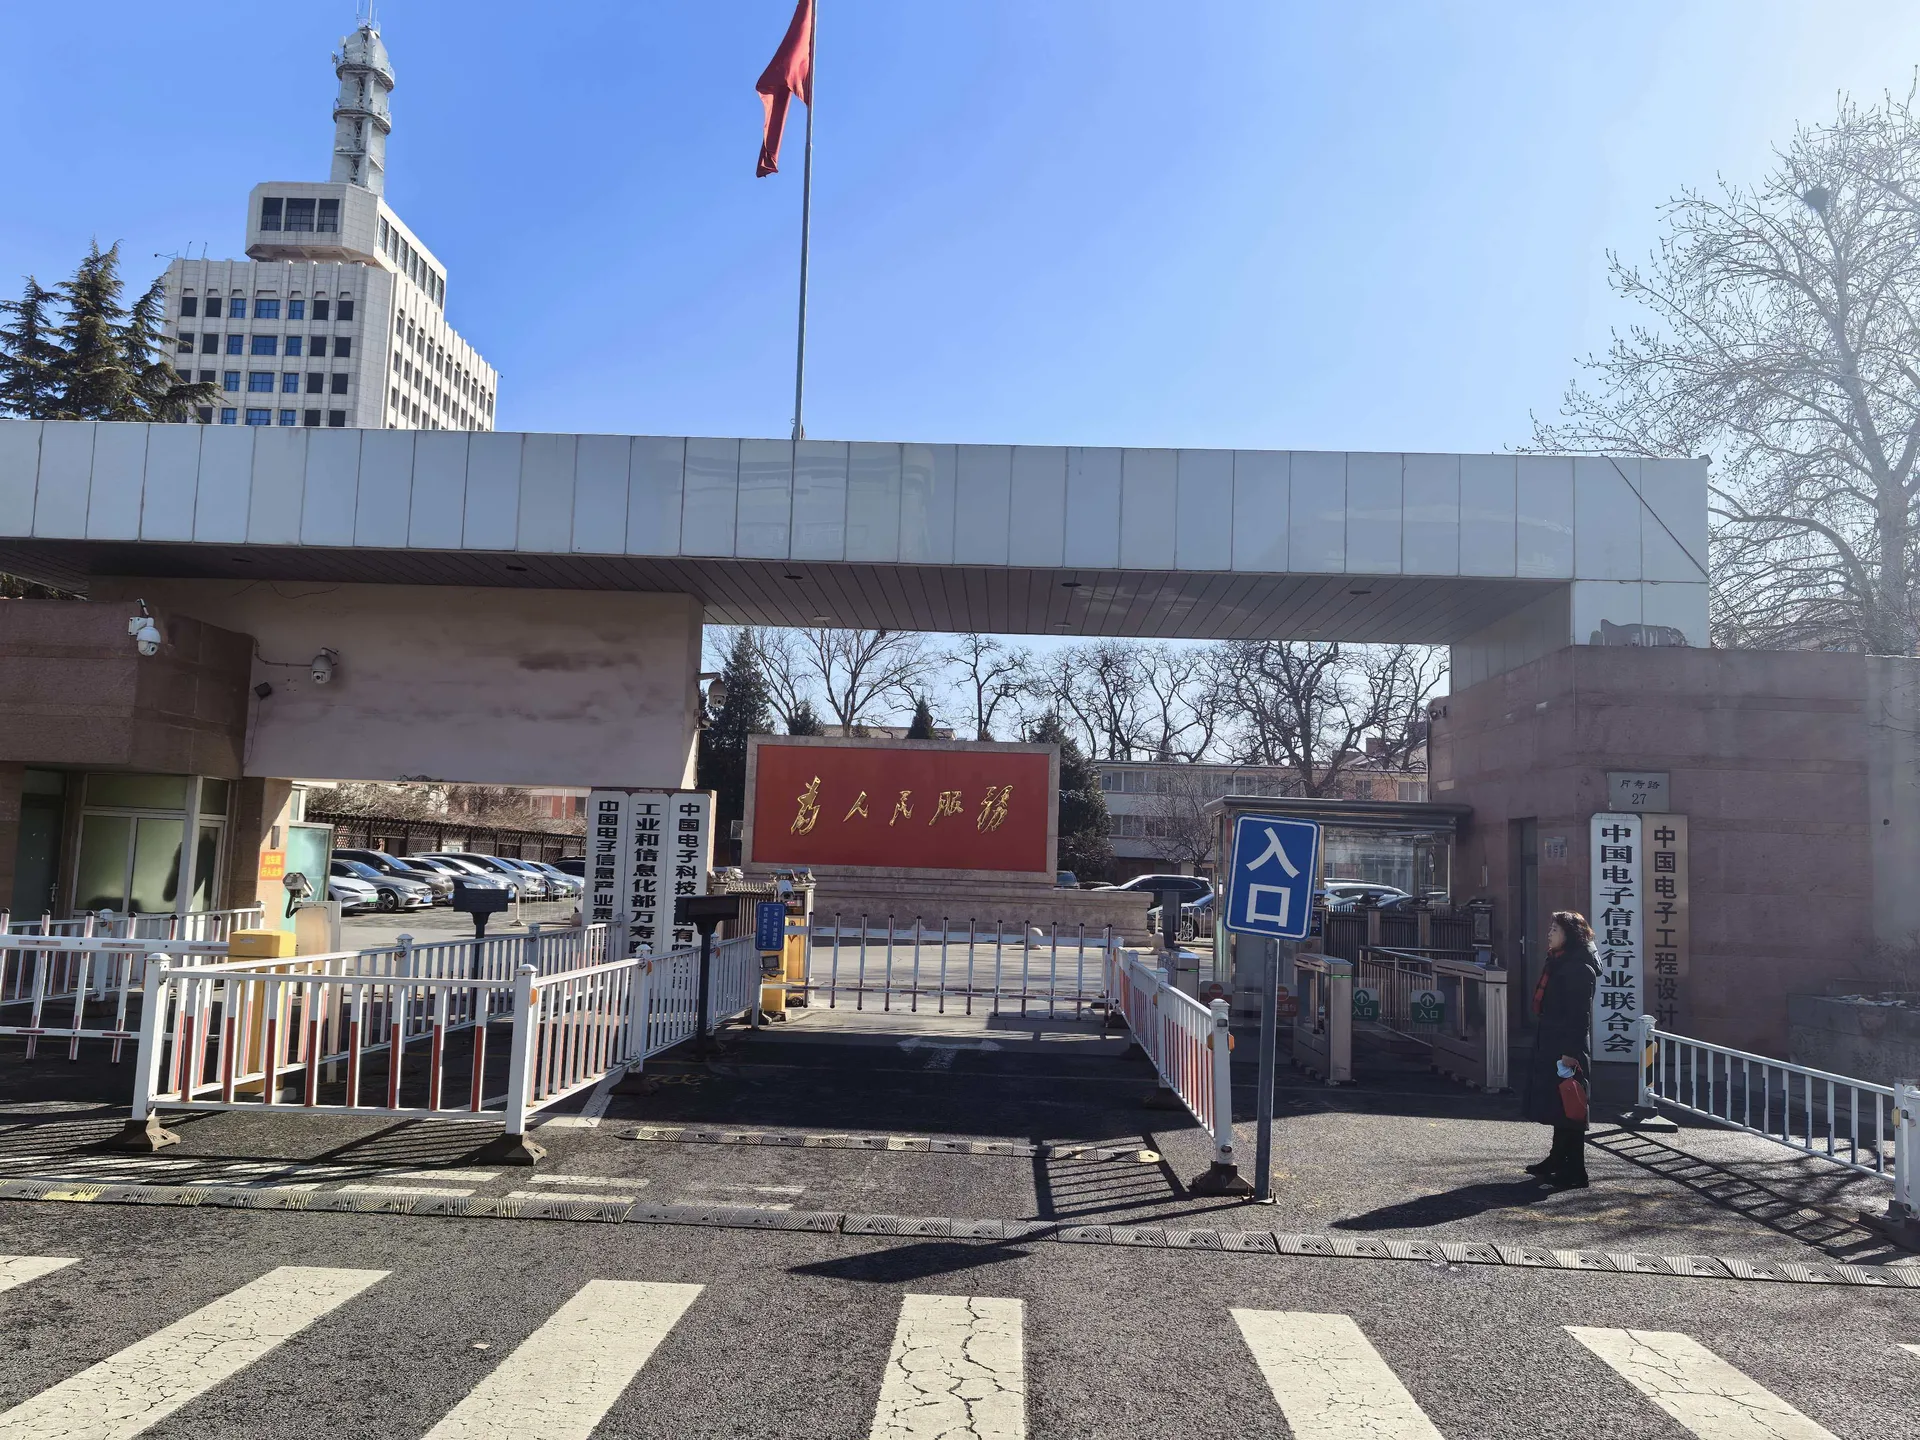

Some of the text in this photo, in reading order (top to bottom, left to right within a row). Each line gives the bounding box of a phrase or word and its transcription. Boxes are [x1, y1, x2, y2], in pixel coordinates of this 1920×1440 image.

[1632, 793, 1647, 805] 27
[590, 800, 620, 948] 中国电子信息产业集
[628, 803, 662, 957] 工业和信息化部万寿路
[1245, 826, 1300, 928] 入口
[1653, 824, 1679, 1029] 中国电子工程设计
[1599, 823, 1636, 1054] 中国电子信息行业联合会
[1352, 1007, 1372, 1016] 入口
[1418, 1009, 1439, 1019] 入口
